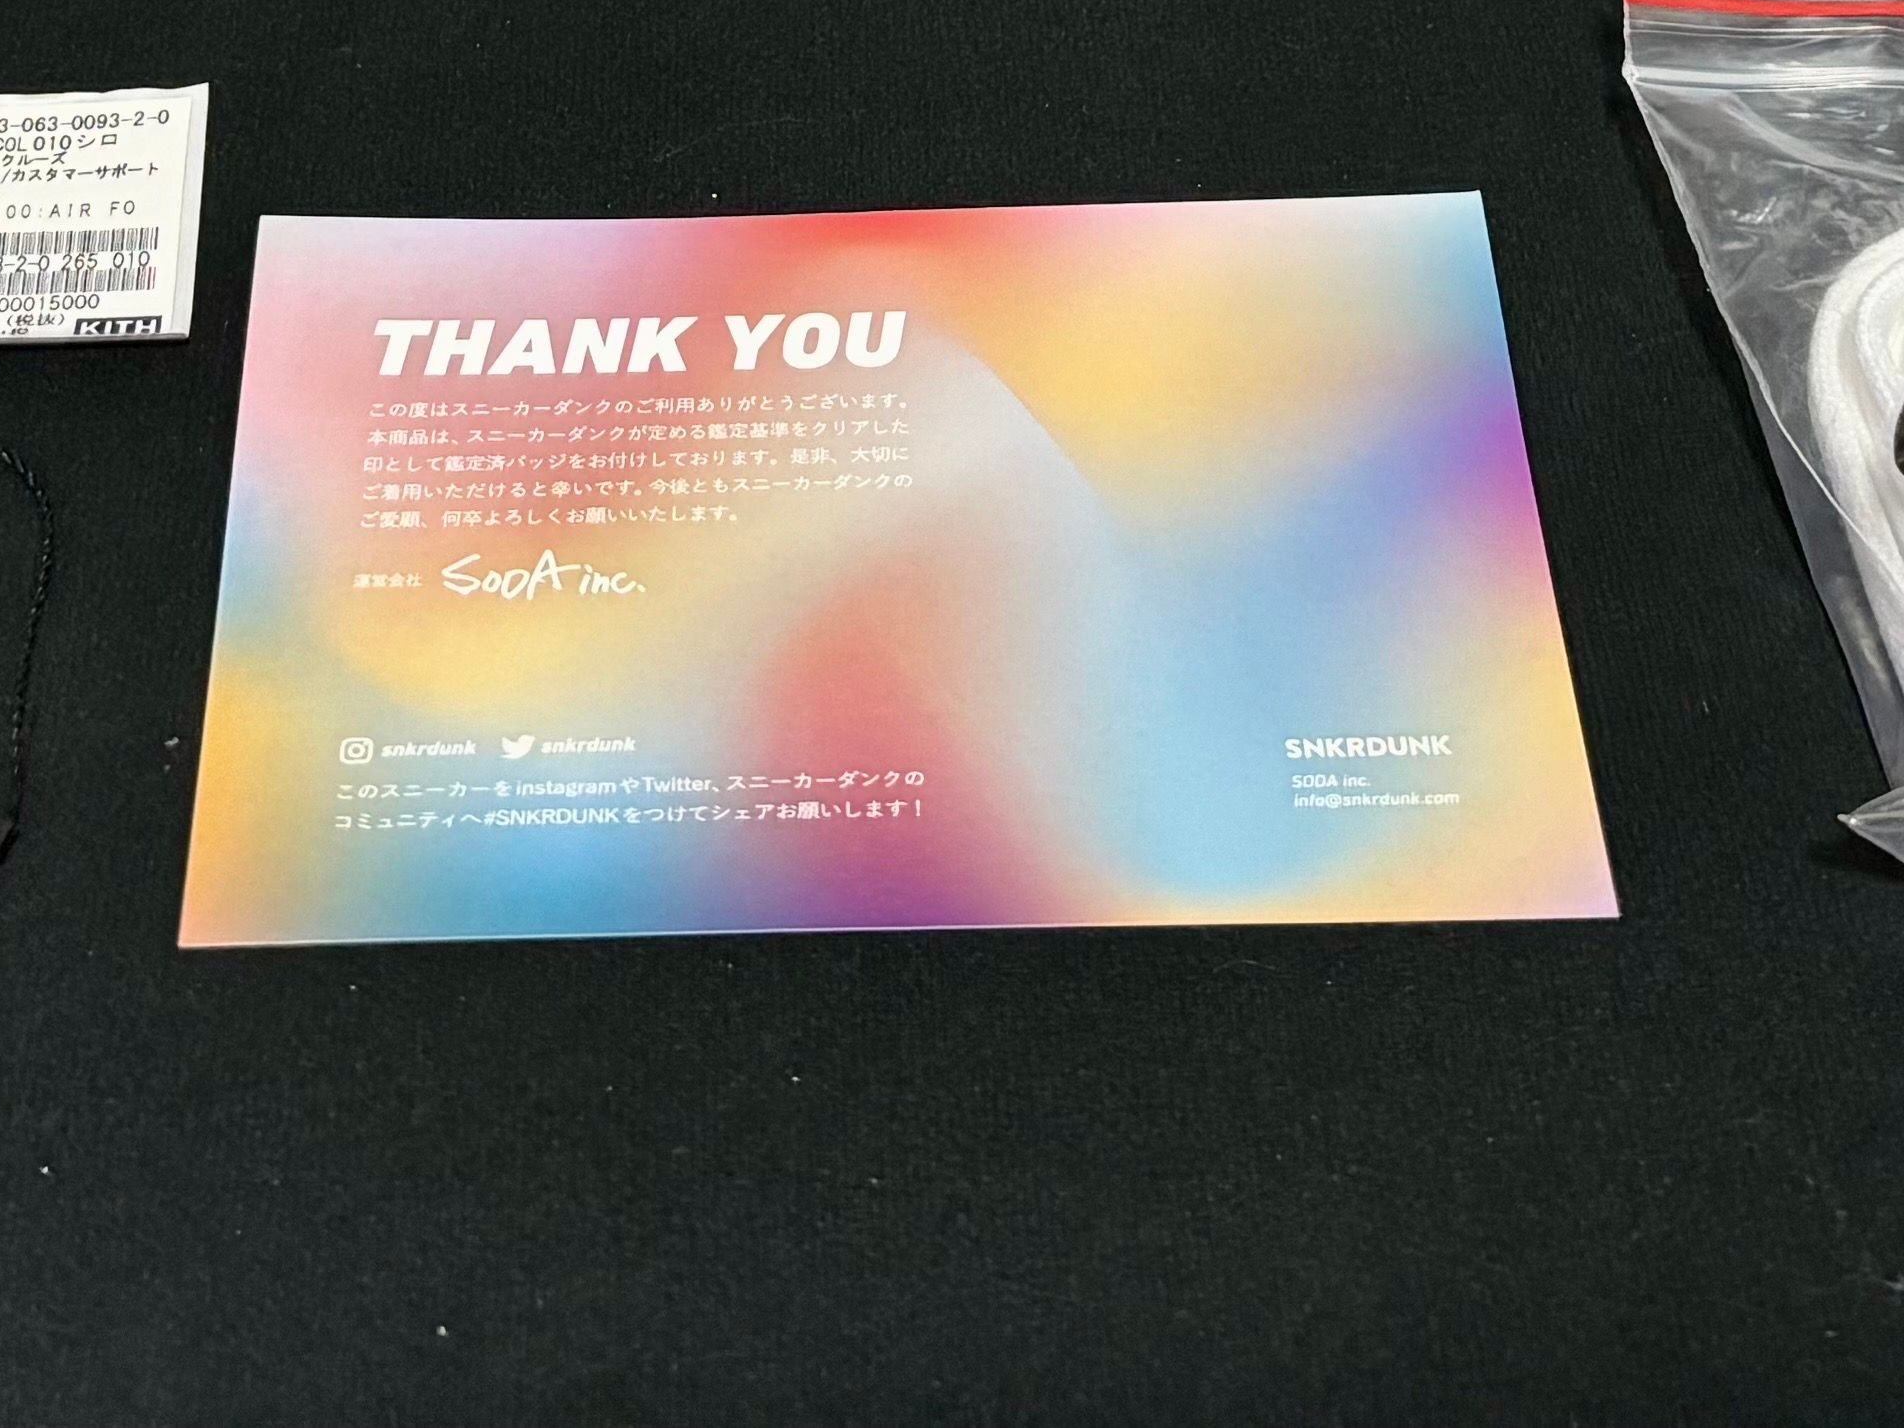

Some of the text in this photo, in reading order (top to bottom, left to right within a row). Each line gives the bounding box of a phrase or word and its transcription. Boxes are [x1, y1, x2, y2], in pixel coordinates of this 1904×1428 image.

[110, 200, 135, 216] FO
[61, 253, 98, 271] 265
[113, 250, 151, 270] 010
[78, 318, 158, 335] KITH
[372, 311, 907, 377] THANK YOU
[579, 563, 646, 595] inc.
[381, 736, 637, 758] snkrdunk snkrdunk
[1284, 735, 1453, 760] SNKRDUNK
[1291, 774, 1372, 789] SODA inc.
[1294, 791, 1461, 809] info@snkrdunk.com
